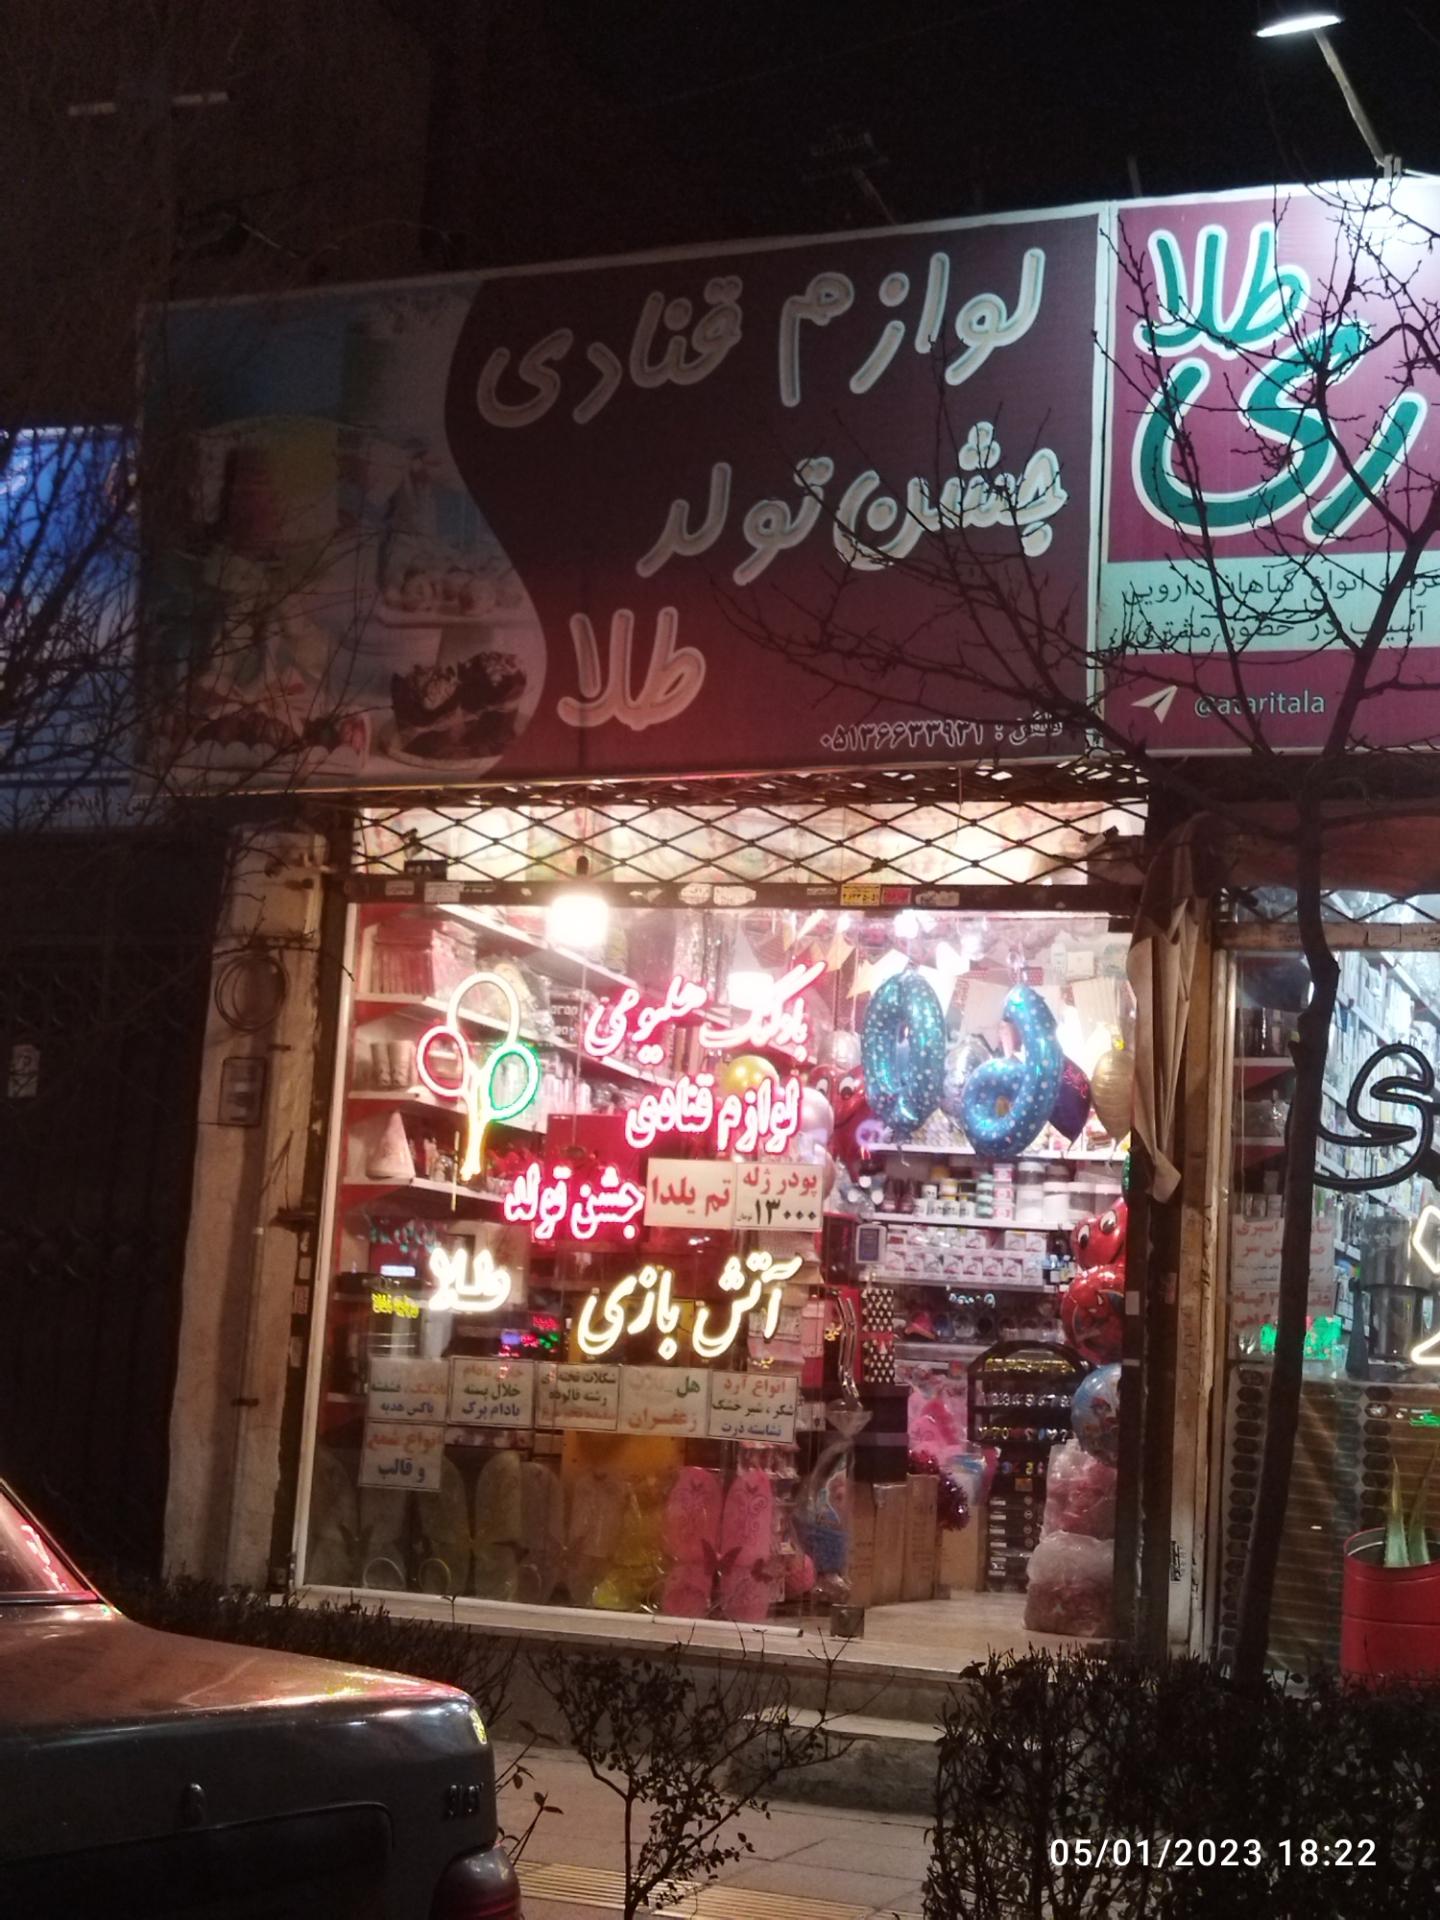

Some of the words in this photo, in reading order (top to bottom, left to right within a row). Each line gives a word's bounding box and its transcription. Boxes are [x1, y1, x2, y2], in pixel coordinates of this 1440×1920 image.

[1133, 222, 1311, 359] طلا
[477, 274, 743, 428] قنادی
[779, 247, 1045, 407] لوازم
[636, 456, 835, 586] تولد
[833, 421, 1069, 571] جشن
[557, 606, 706, 731] طلا
[584, 975, 708, 1065] هلیومی
[717, 1076, 800, 1153] لوازم
[504, 1162, 572, 1240] تولد
[571, 1166, 646, 1240] جشن
[651, 1175, 697, 1215] یلدا
[705, 1178, 732, 1218] تم
[743, 1166, 771, 1195] ژله
[755, 1198, 817, 1225] ۱۳۰۰۰
[776, 1171, 818, 1198] پودر
[428, 1246, 513, 1313] طلا
[577, 1264, 681, 1361] بازی
[691, 1250, 803, 1358] آتش
[490, 1402, 521, 1419] بادام
[491, 1381, 521, 1401] خلال
[627, 1407, 698, 1434] زعفران
[676, 1375, 701, 1399] هل
[752, 1379, 786, 1399] انواع
[378, 1456, 414, 1479] قالب
